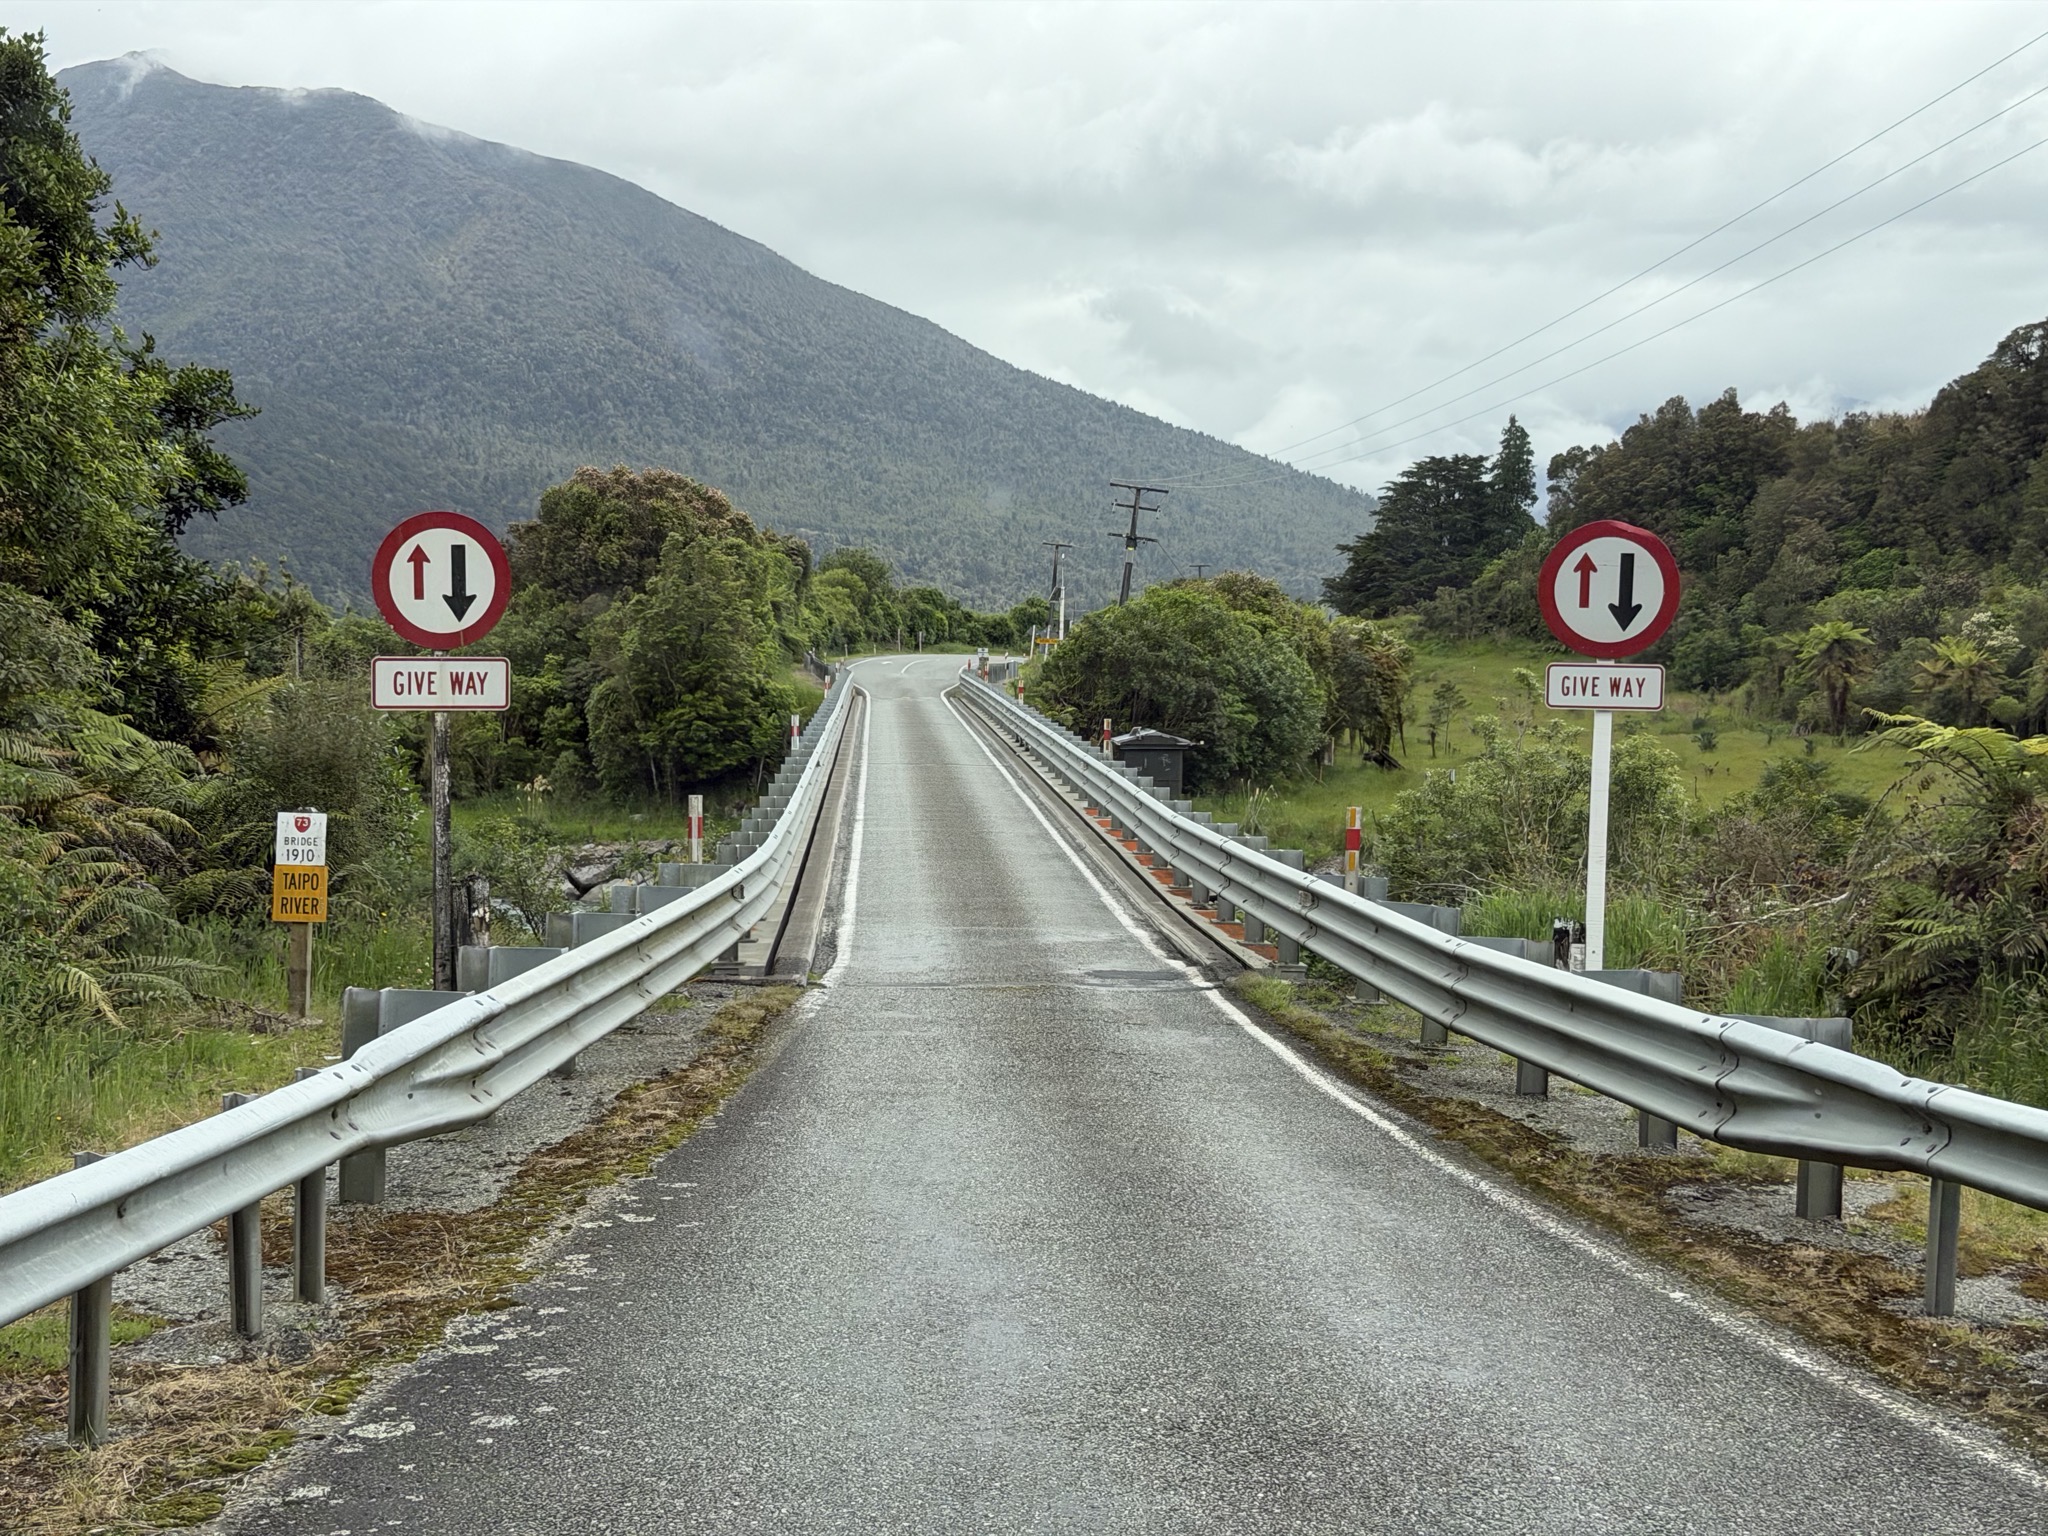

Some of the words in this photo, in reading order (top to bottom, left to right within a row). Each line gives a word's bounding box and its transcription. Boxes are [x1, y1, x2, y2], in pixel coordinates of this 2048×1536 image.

[393, 671, 437, 696] GIVE
[449, 671, 489, 696] WAY
[1561, 675, 1600, 697] GIVE
[1609, 676, 1646, 698] WAY
[296, 818, 309, 827] 73
[284, 836, 319, 847] BRIDGE
[286, 848, 315, 863] 1910
[283, 872, 320, 891] TAIPO
[280, 896, 320, 915] RIVER
